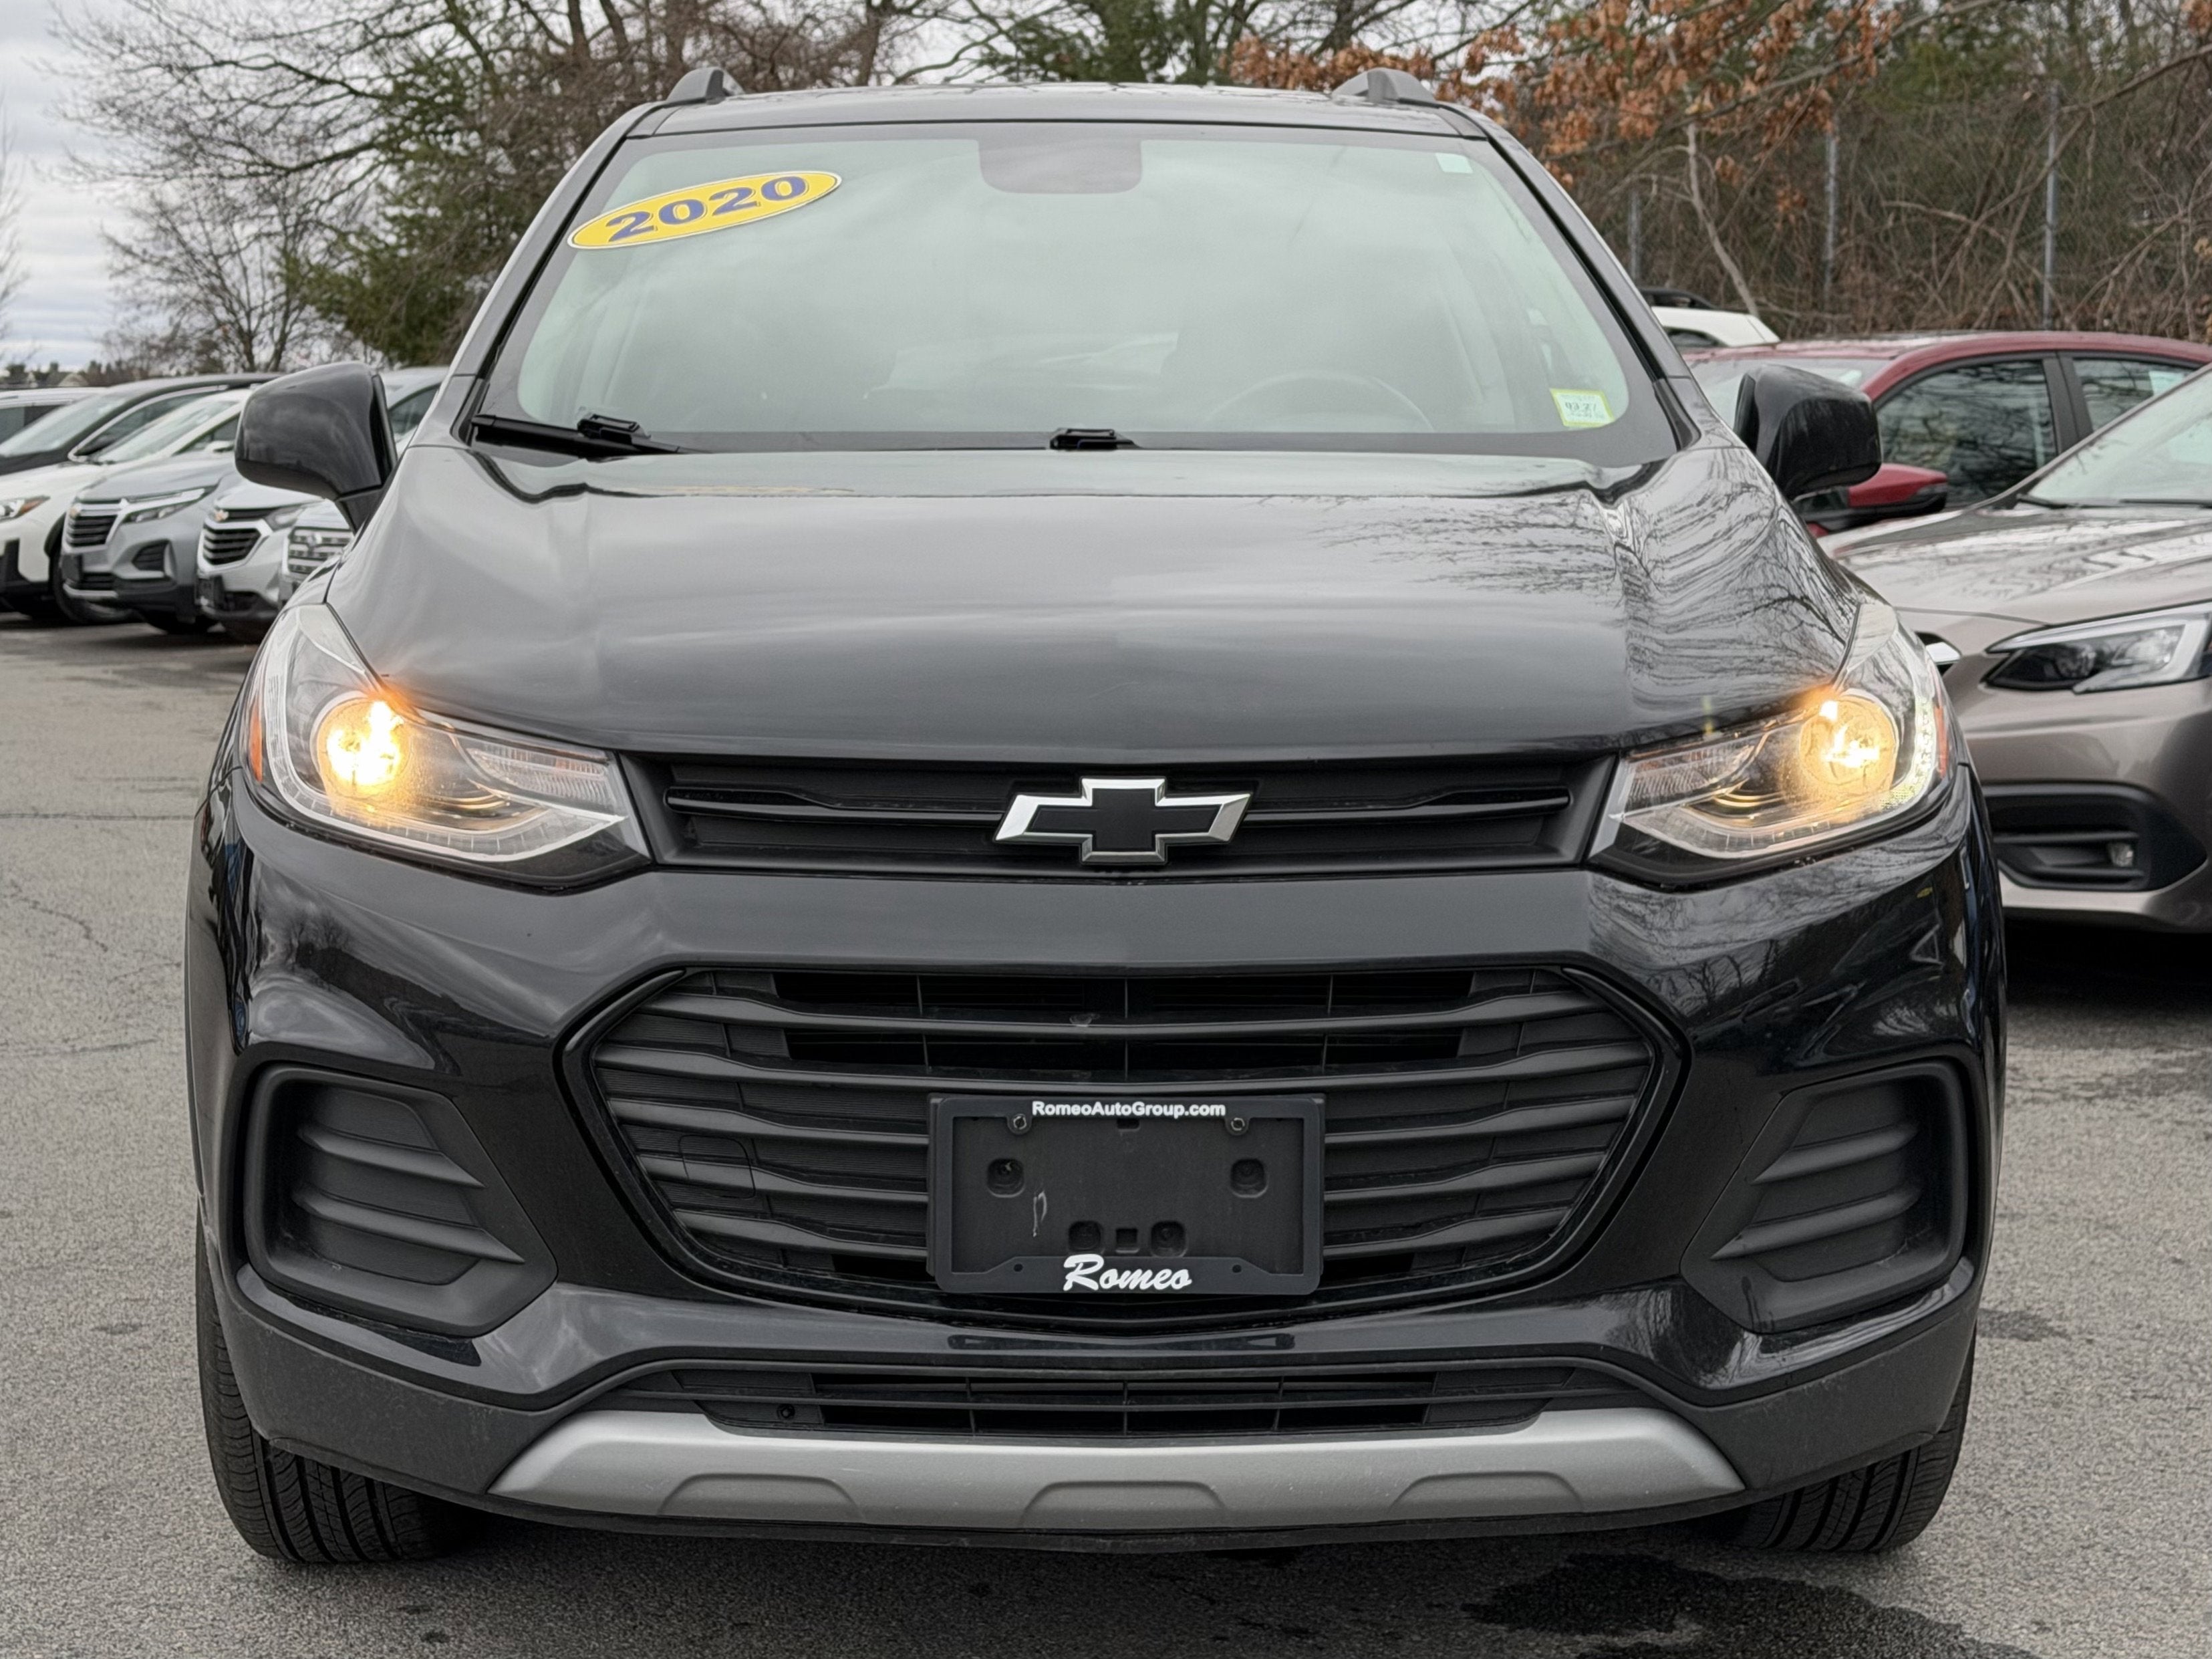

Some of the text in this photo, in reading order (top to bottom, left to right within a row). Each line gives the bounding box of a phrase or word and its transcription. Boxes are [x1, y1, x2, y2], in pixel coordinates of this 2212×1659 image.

[606, 176, 809, 241] 2020
[1032, 1101, 1226, 1118] RomeoAutoGroup.com
[1063, 1253, 1193, 1291] Romeo
